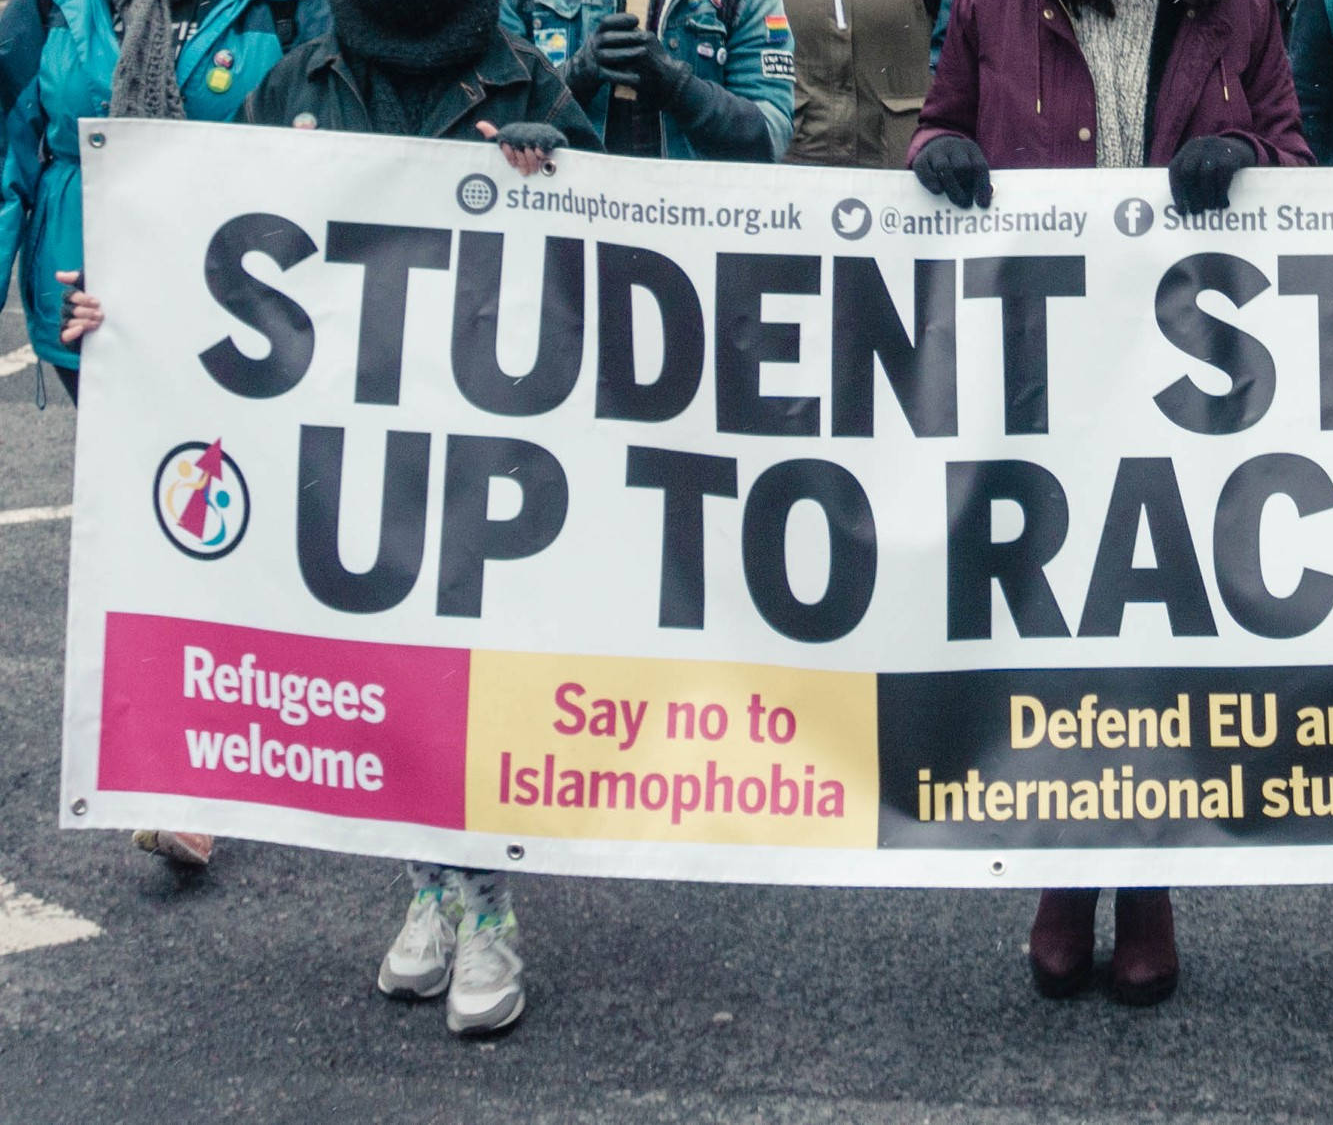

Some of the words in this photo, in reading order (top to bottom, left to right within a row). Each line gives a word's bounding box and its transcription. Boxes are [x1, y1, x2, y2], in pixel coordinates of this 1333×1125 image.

[506, 181, 803, 233] standuptoracism.org.uk
[880, 204, 1088, 238] @antiracismday
[1163, 203, 1267, 233] Student
[197, 211, 1087, 438] STUDENT
[296, 424, 569, 619] UP
[626, 445, 879, 644] TO
[183, 645, 386, 725] Refugees
[552, 682, 648, 751] Say
[665, 699, 729, 743] no
[749, 693, 798, 745] to
[185, 721, 385, 793] welcome
[1009, 693, 1192, 751] Defend
[1208, 692, 1279, 749] EU
[499, 751, 847, 825] Islamophobia
[918, 764, 1245, 823] international
